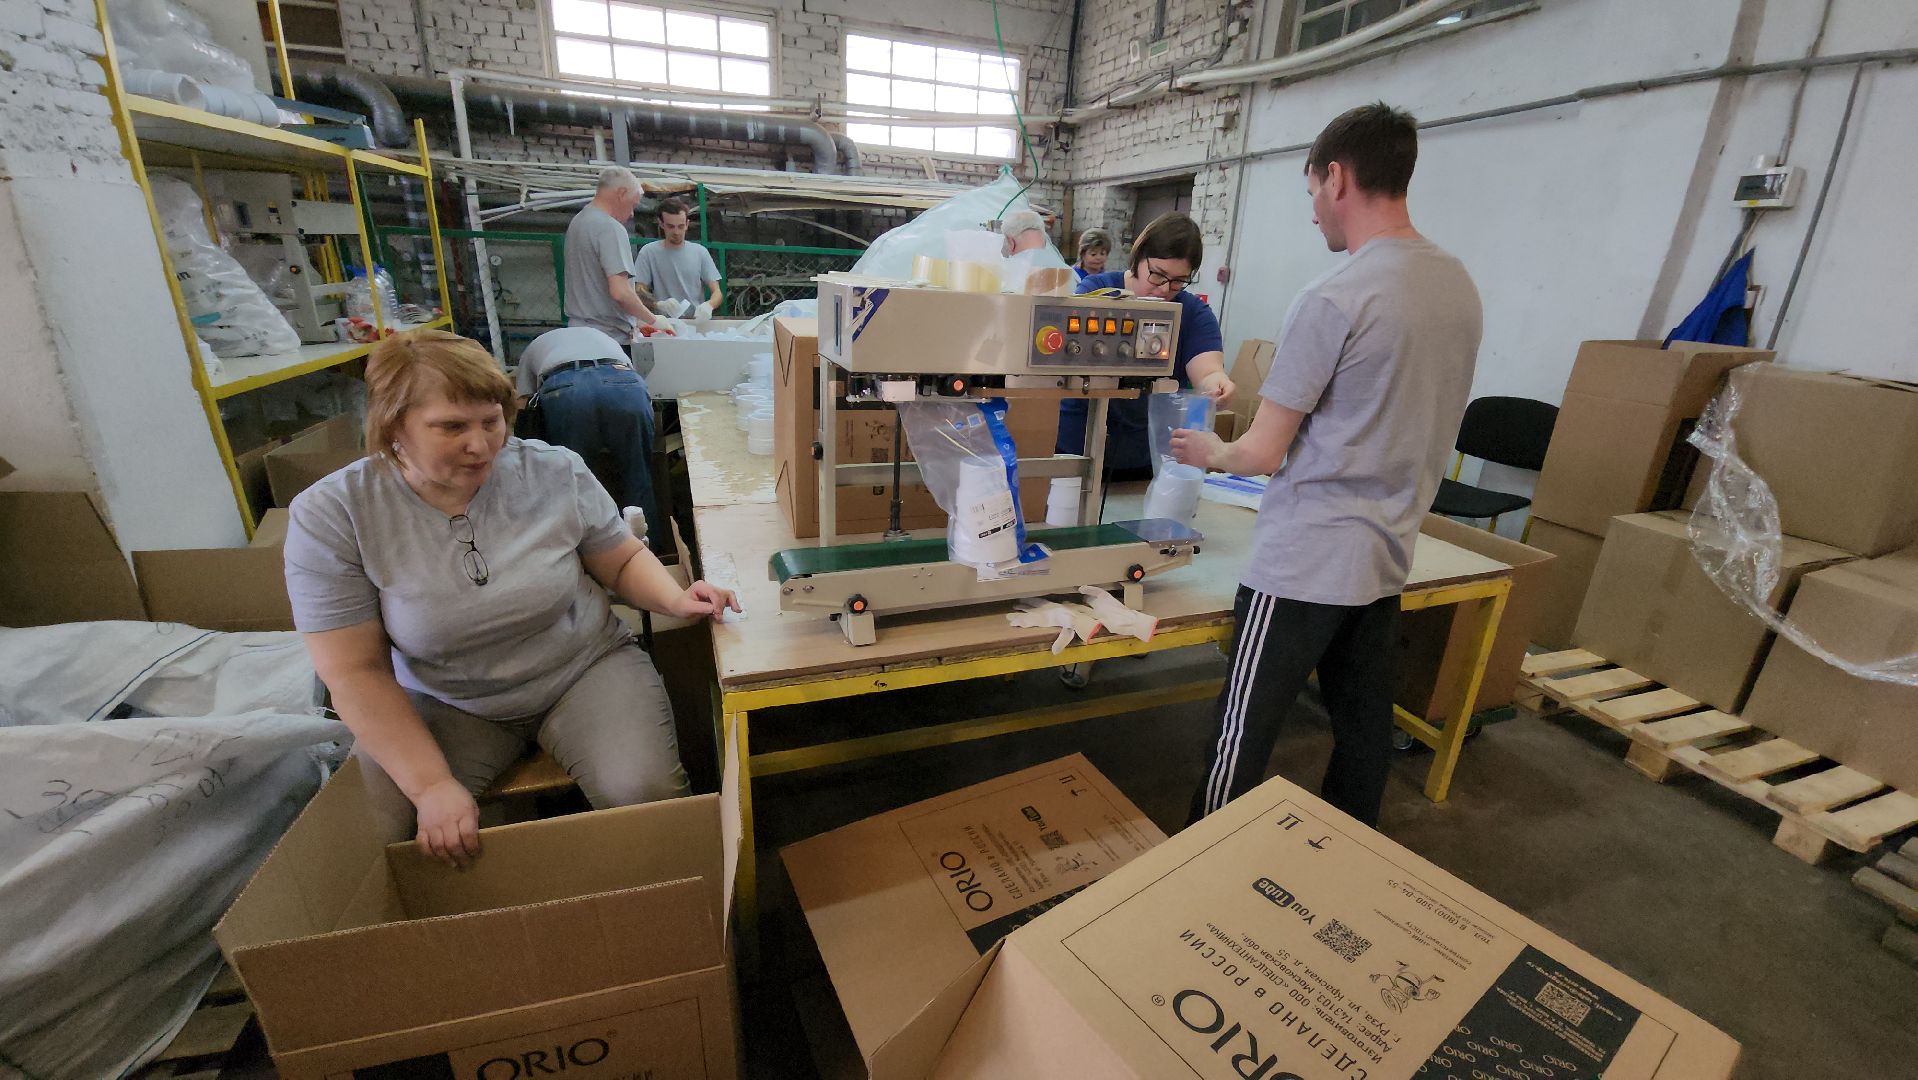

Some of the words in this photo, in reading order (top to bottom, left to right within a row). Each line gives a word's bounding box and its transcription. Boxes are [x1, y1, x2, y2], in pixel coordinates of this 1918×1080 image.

[940, 852, 993, 911] ORIO
[1180, 930, 1250, 986] РОССИИ
[1207, 923, 1288, 987] «СПЕЦСАНТЕХНИКА»
[1276, 949, 1290, 960] 55
[1260, 950, 1315, 994] Московская
[1304, 966, 1344, 1001] Красная,
[1254, 988, 1266, 998] в
[1289, 989, 1310, 1006] ООО
[1317, 992, 1352, 1024] 143103,
[1348, 1000, 1362, 1012] ул.
[1172, 989, 1306, 1080] RIO
[1312, 1005, 1382, 1064] Изготовитель:
[1357, 1023, 1392, 1053] Адрес:
[1365, 1011, 1390, 1036] Руза,
[1393, 1034, 1401, 1043] г.
[1269, 1002, 1367, 1080] СДЕЛАНО
[1443, 1046, 1476, 1063] ORIO
[1466, 1041, 1499, 1057] ORIO
[477, 1037, 610, 1080] ORIO
